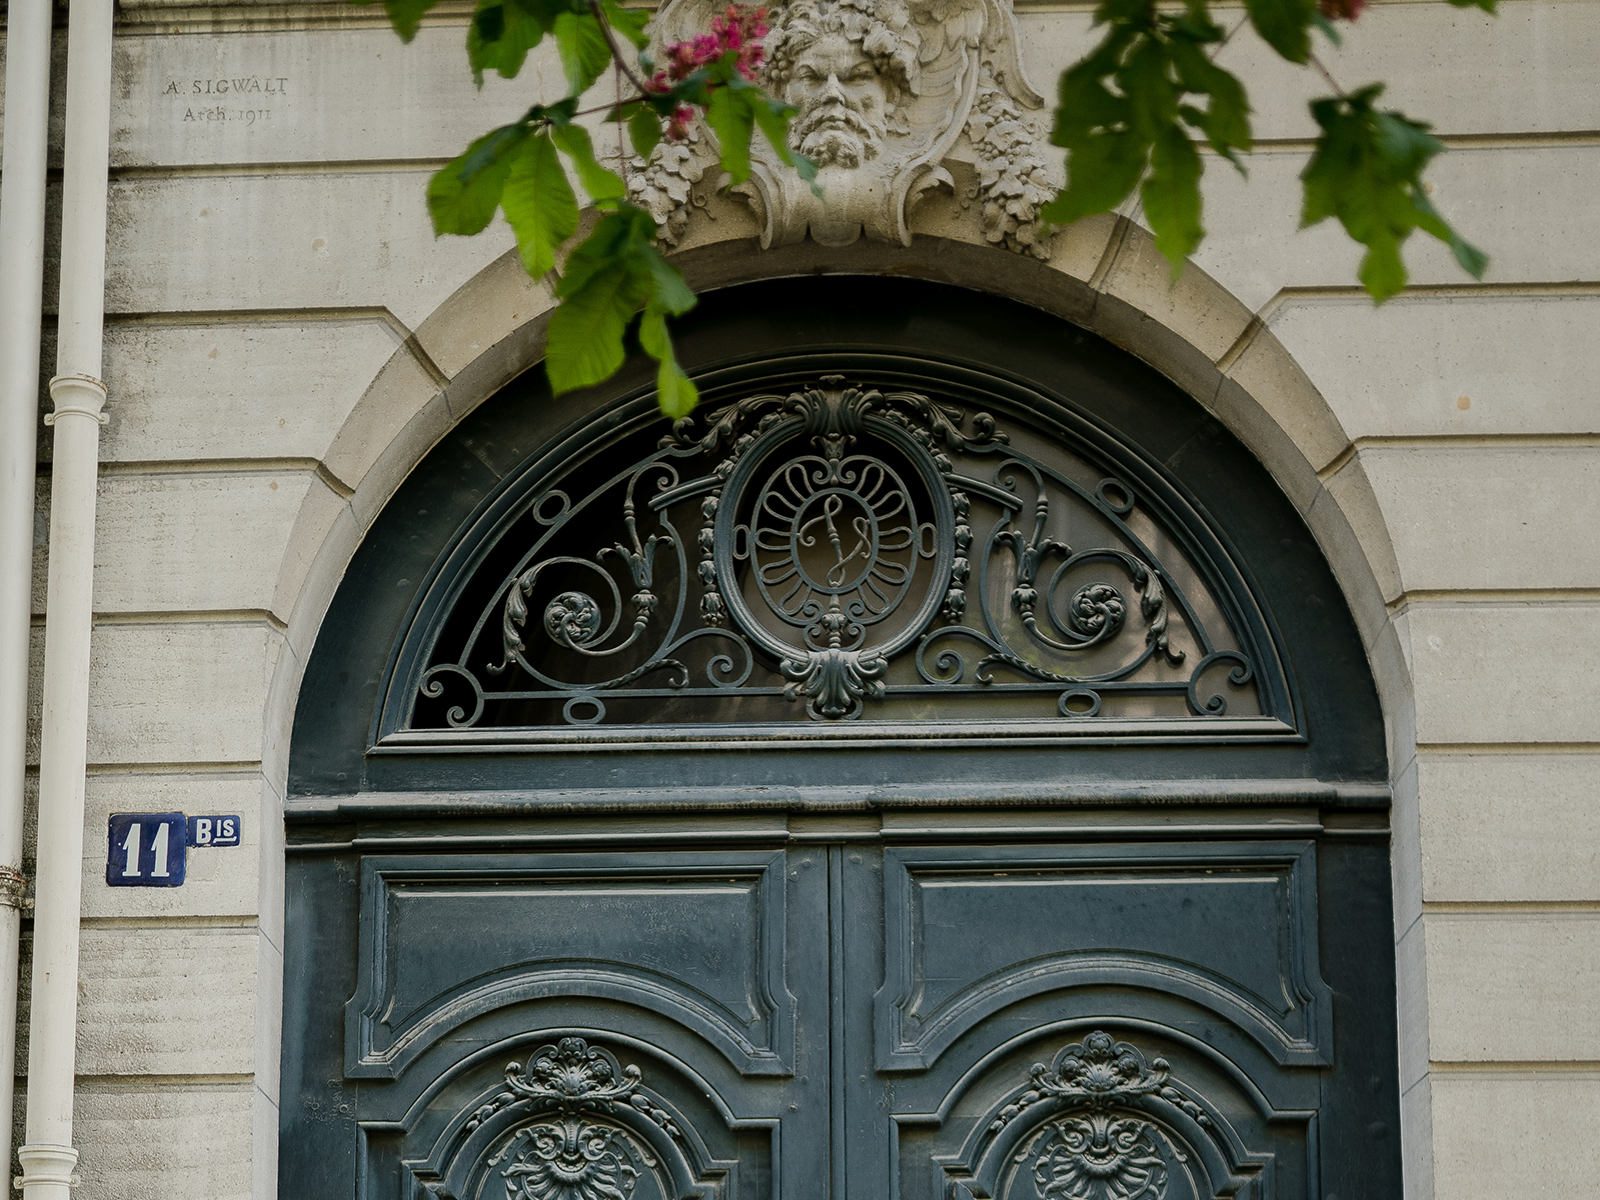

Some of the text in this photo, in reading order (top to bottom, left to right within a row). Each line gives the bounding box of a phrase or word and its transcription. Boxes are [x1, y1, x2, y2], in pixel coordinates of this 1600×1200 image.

[164, 78, 288, 94] A. SIGWALT
[183, 106, 272, 127] Arch. 1911
[122, 822, 170, 877] 11
